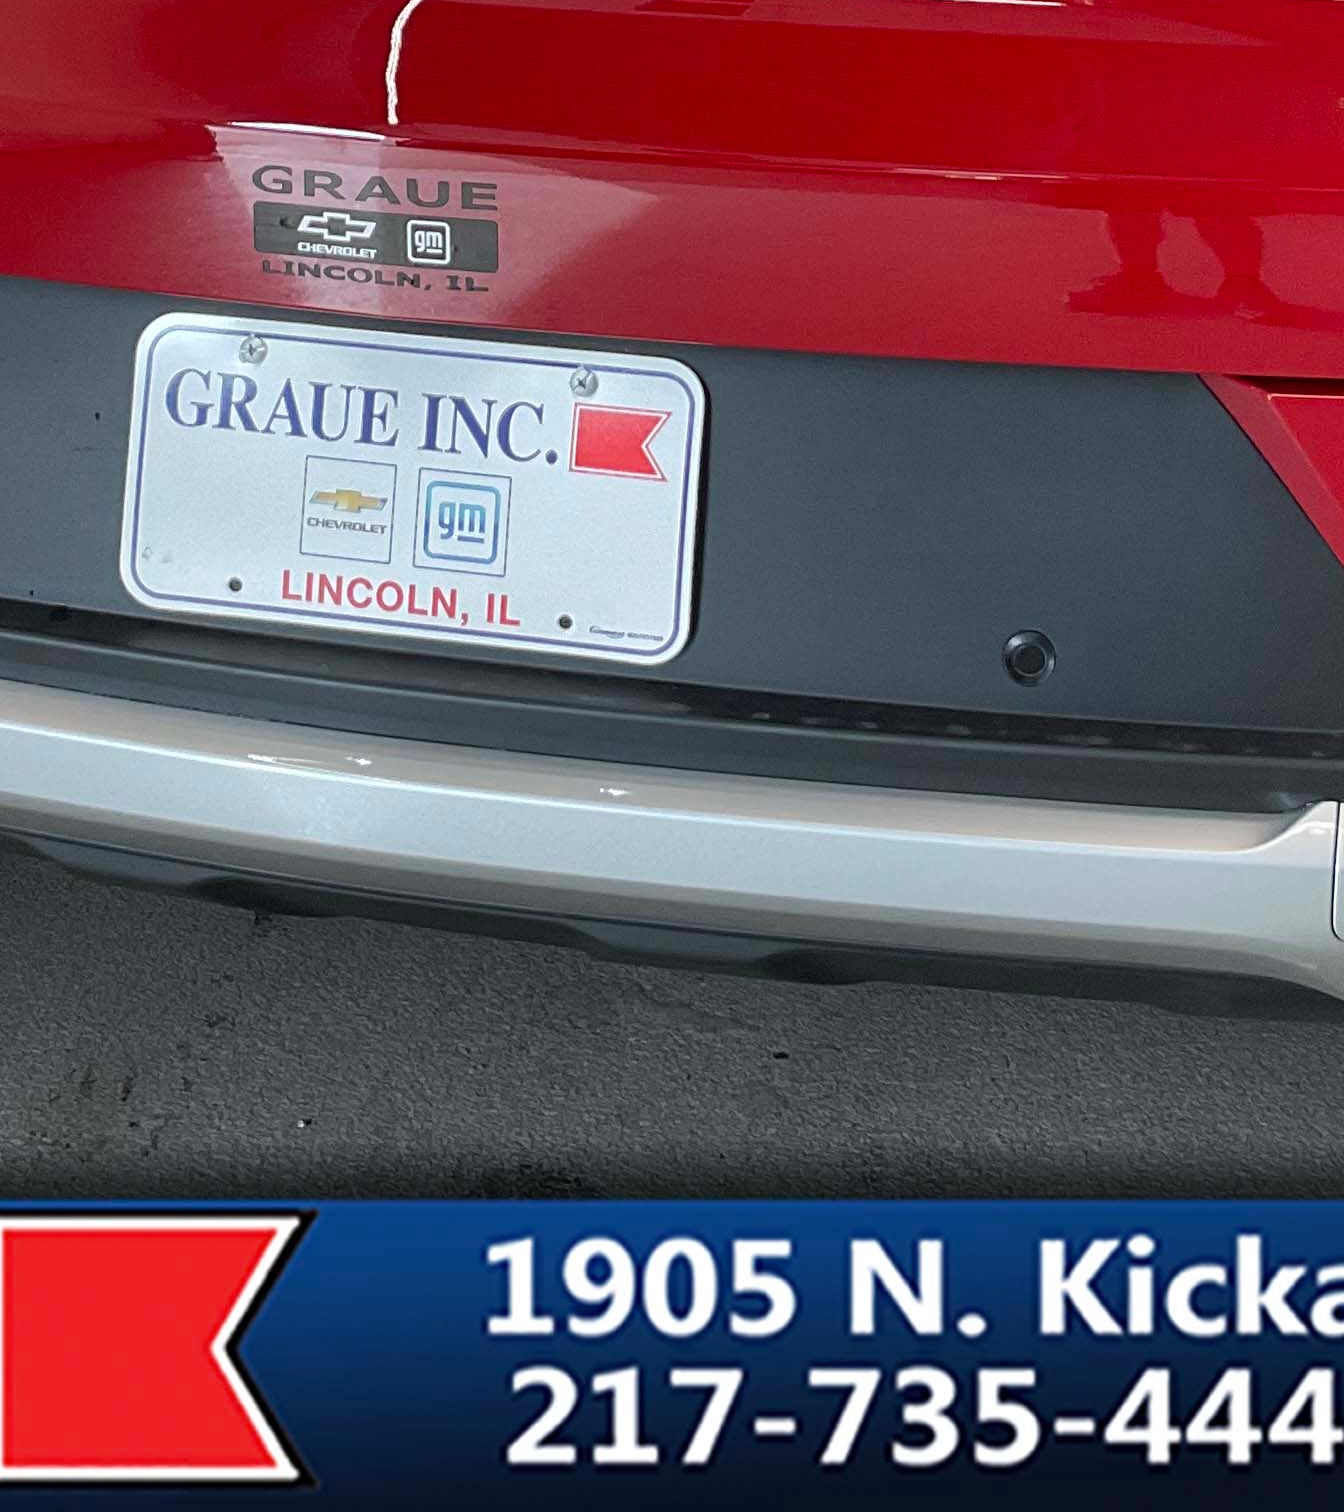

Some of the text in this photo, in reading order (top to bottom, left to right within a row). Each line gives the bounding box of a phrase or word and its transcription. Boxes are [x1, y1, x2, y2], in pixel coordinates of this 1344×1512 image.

[252, 164, 499, 212] GRAUE
[297, 241, 377, 260] CHEVROLET
[414, 230, 444, 254] gm
[262, 260, 489, 292] LINCOLN, IL
[165, 367, 559, 465] GRAUE INC.
[306, 516, 388, 535] CHEVROLET
[437, 501, 487, 541] gm
[281, 569, 521, 626] LINCOLN, IL
